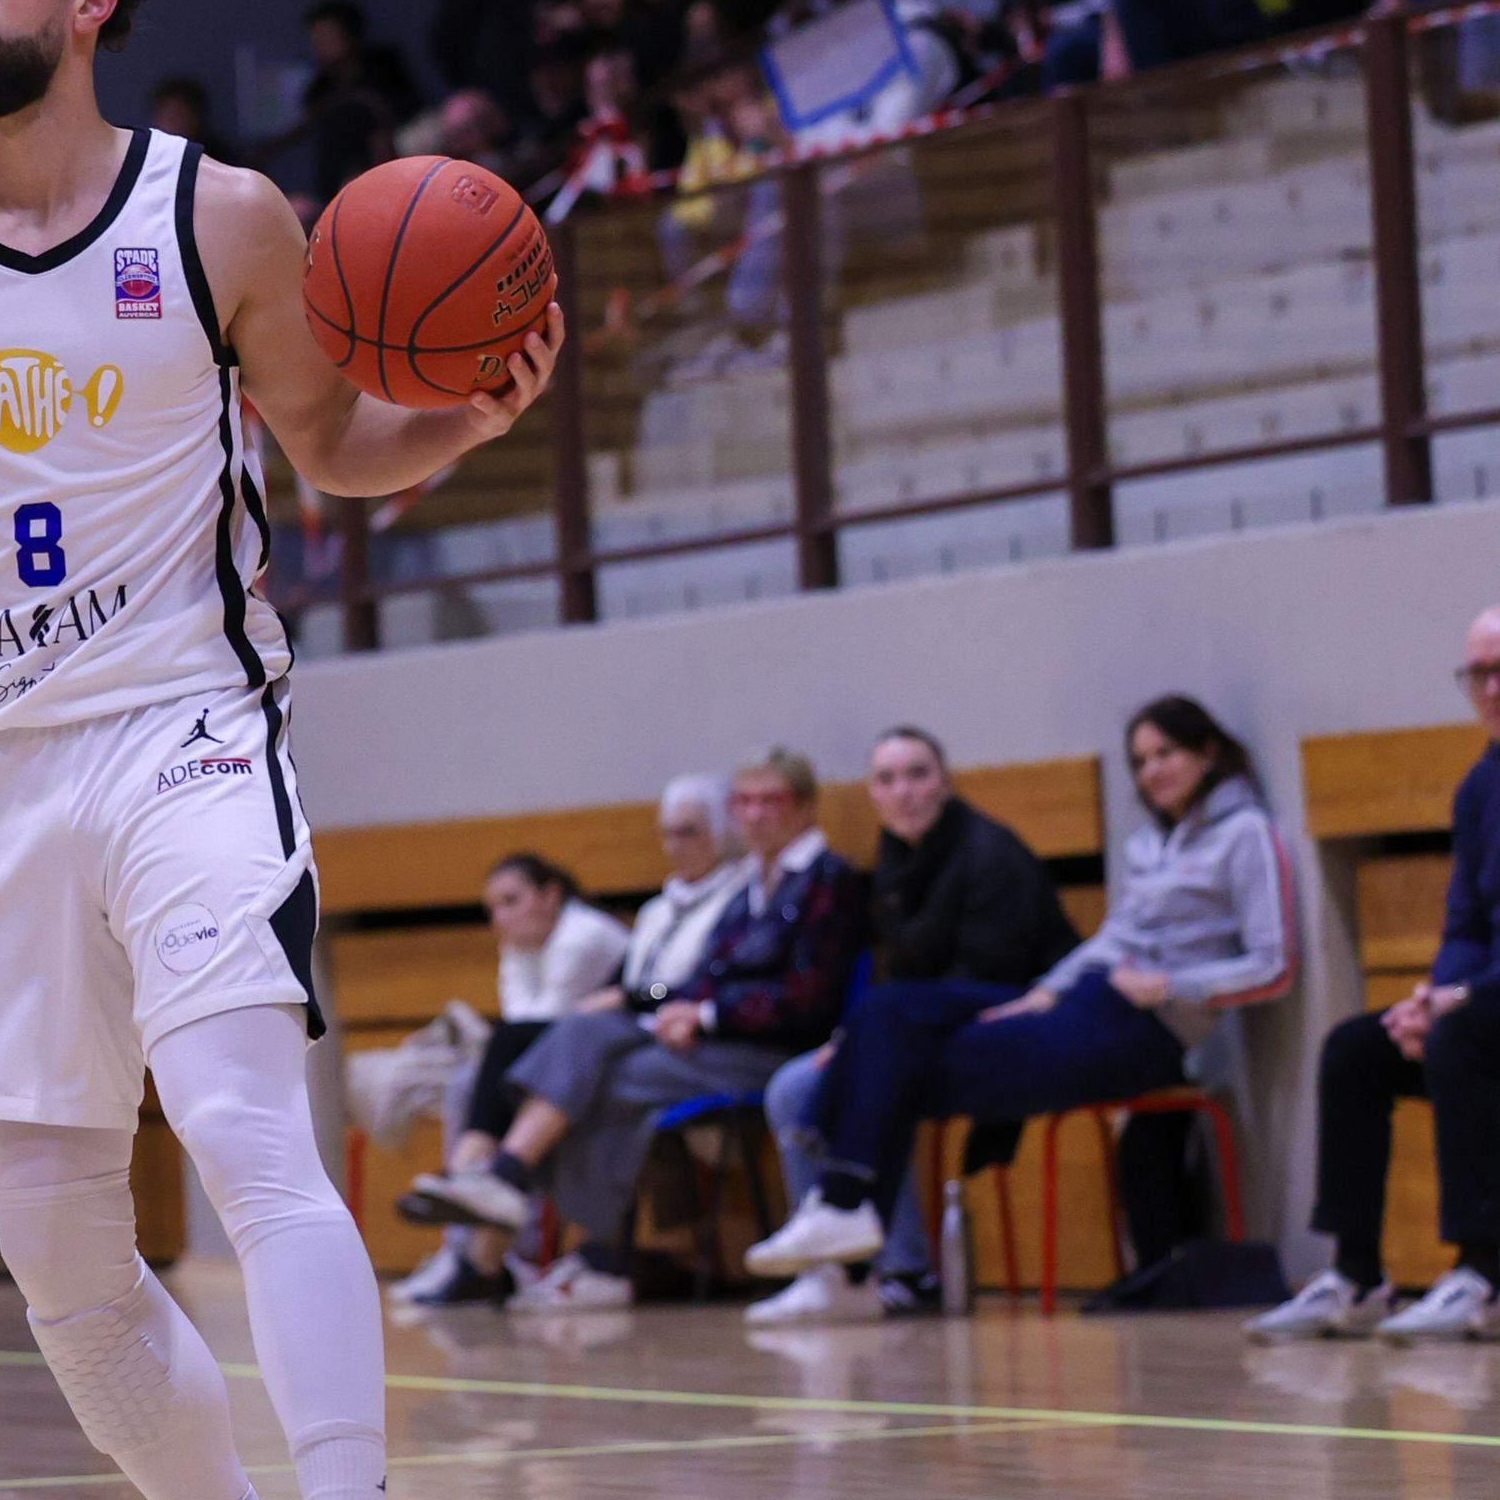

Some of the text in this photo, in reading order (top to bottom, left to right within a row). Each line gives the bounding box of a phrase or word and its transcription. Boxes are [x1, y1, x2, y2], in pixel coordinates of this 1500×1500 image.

[116, 250, 157, 272] STADE
[118, 302, 159, 312] BASKET
[14, 502, 66, 588] 8
